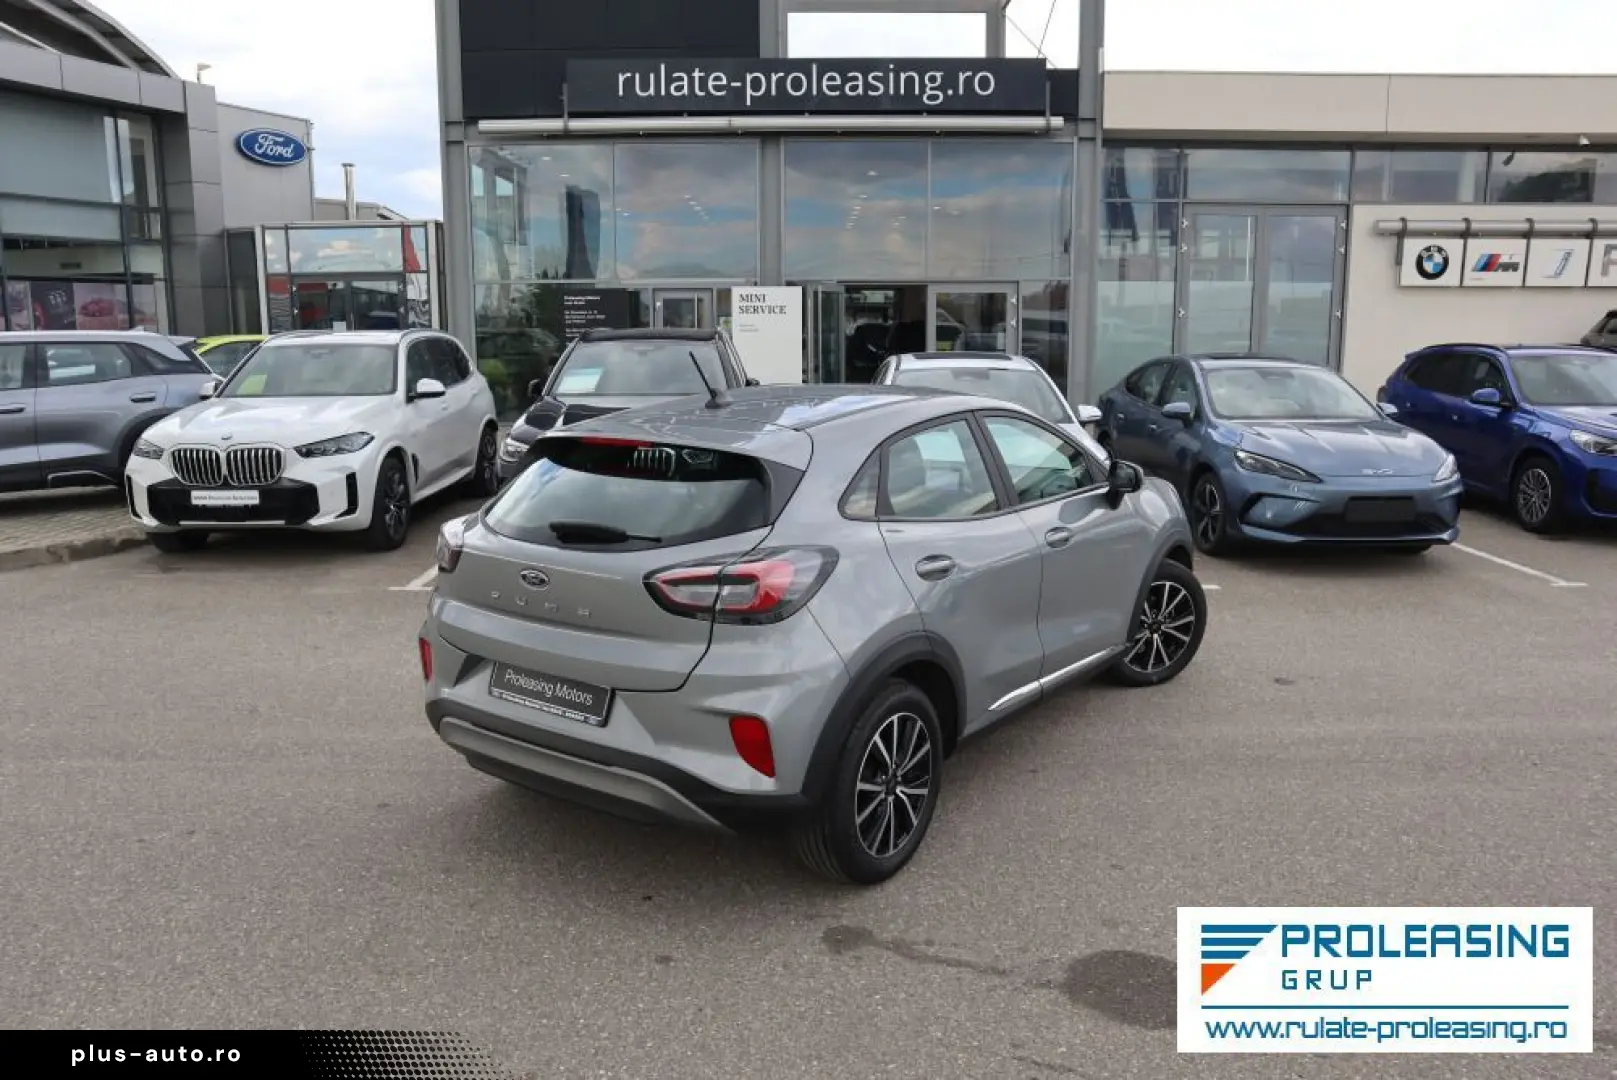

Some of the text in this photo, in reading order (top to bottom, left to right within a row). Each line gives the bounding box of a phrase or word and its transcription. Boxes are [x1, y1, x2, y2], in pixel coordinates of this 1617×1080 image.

[617, 63, 996, 106] rulate-proleasing.ro
[254, 133, 296, 158] Ford
[738, 304, 787, 315] SERVICE
[739, 293, 766, 303] MINI
[504, 668, 593, 706] Proleasing Motors
